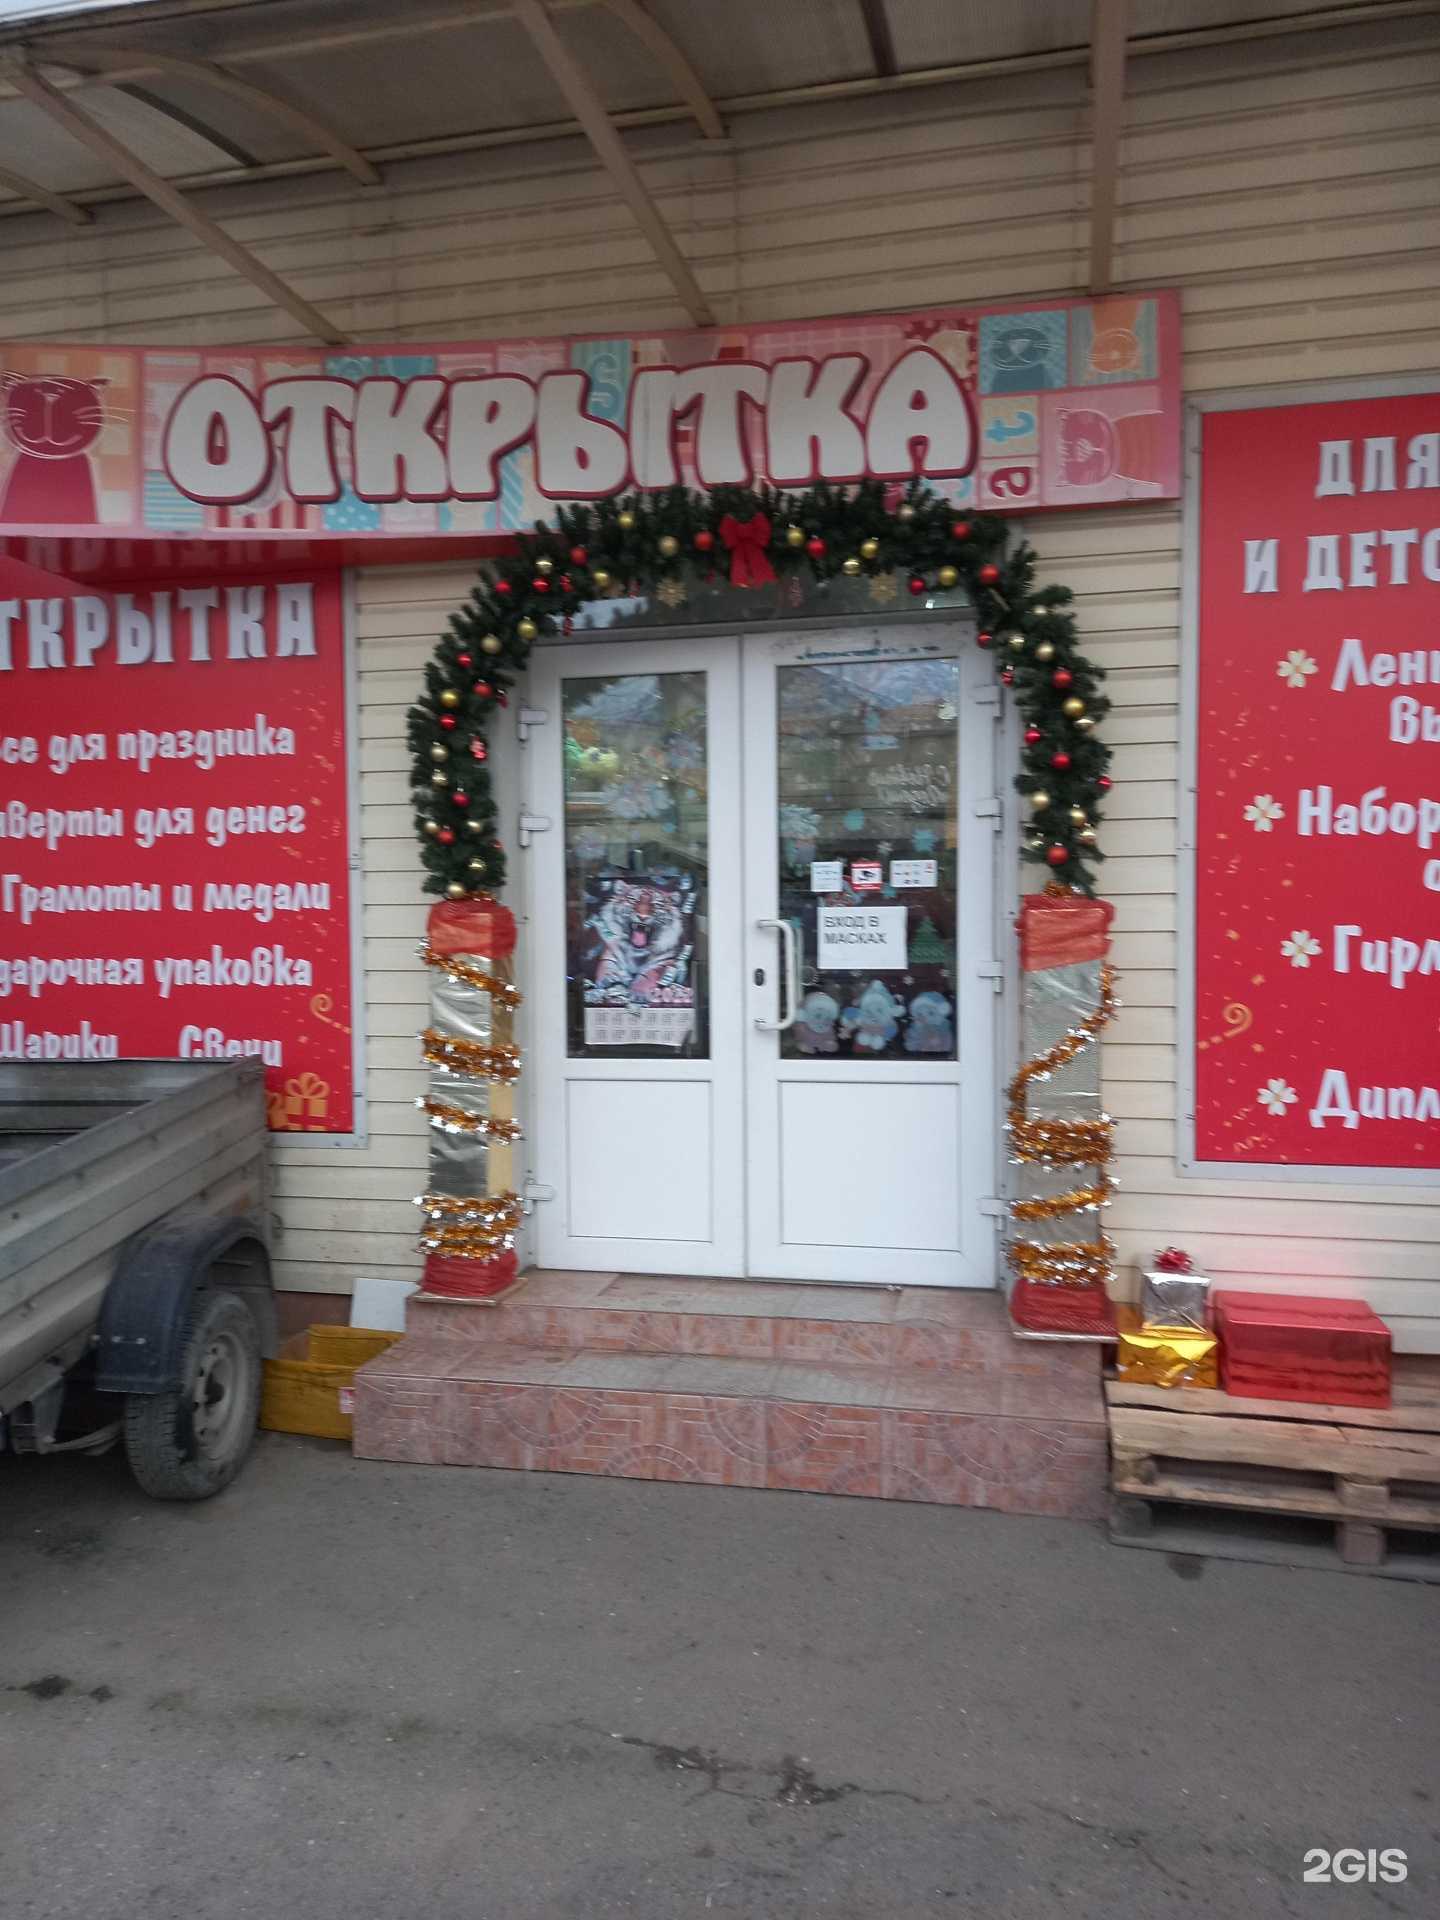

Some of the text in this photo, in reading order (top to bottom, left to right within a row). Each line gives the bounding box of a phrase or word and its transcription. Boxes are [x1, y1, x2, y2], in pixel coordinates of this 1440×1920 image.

[163, 344, 979, 505] ОТКРЫТКА
[1242, 538, 1280, 594] И
[49, 733, 107, 774] для
[117, 712, 296, 773] праздника
[0, 800, 306, 851] верты для денег
[2, 873, 331, 925] Грамоты и медали
[824, 915, 881, 931] ВХОД В
[824, 932, 889, 945] МАСКАХ
[154, 944, 313, 999] упаковка
